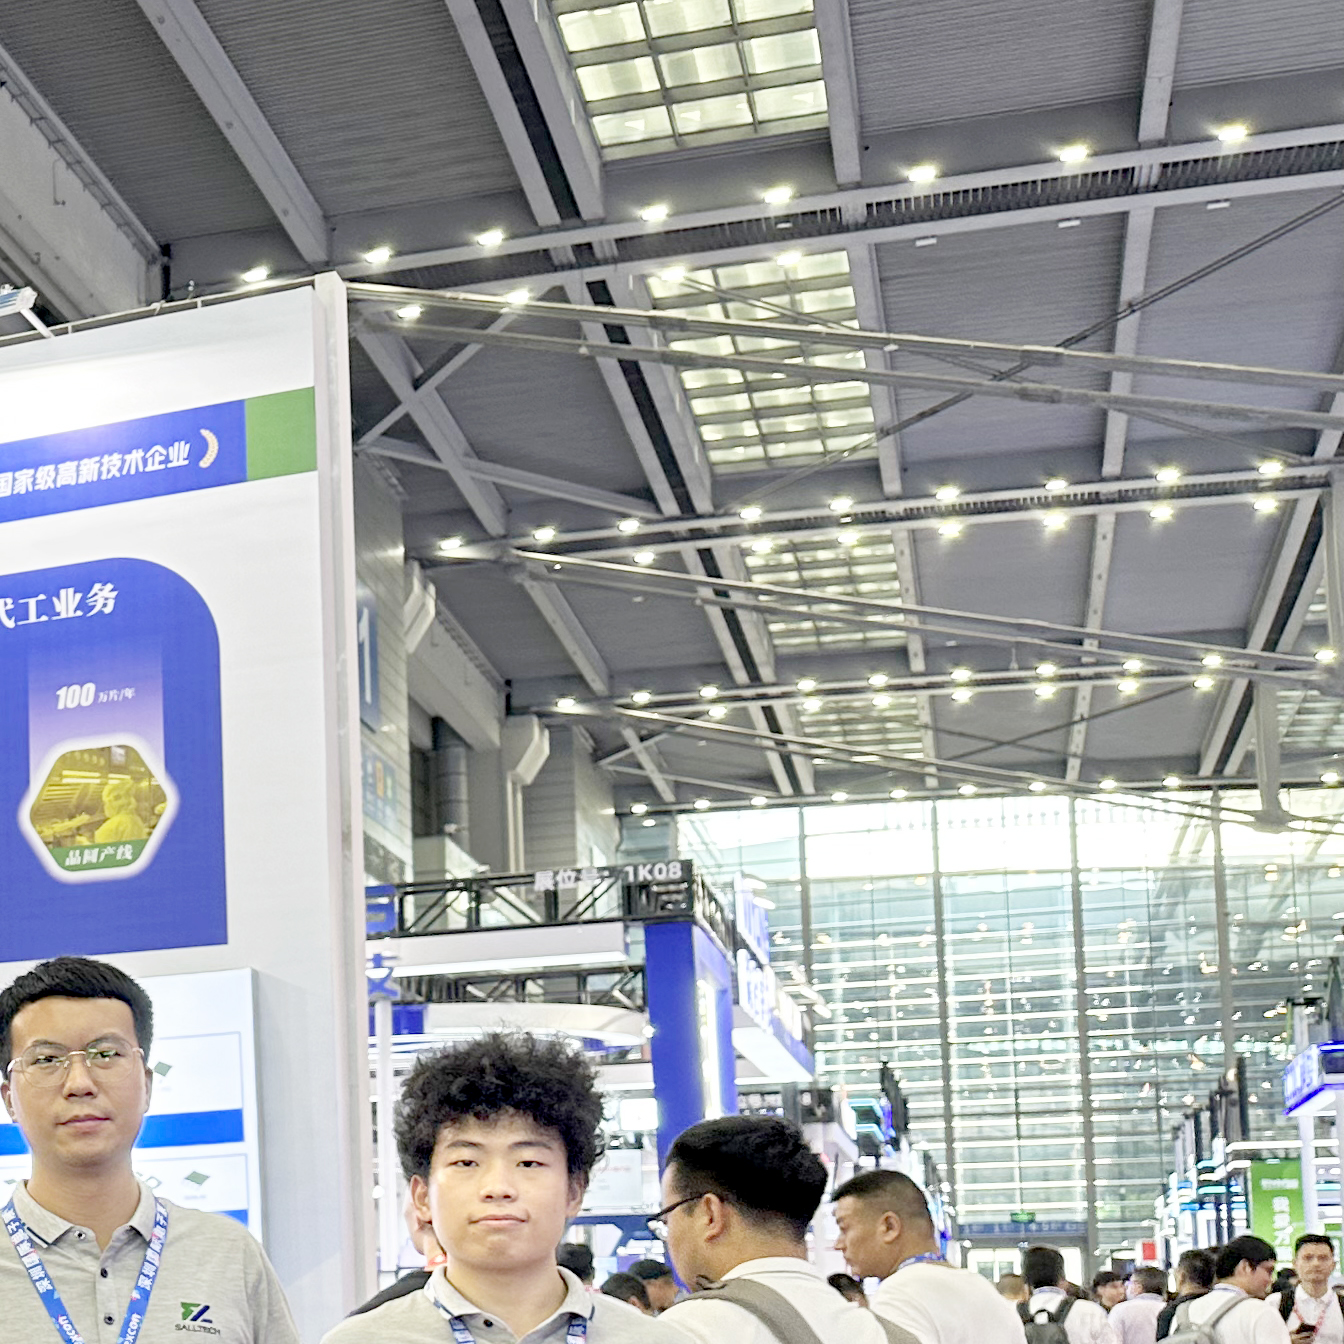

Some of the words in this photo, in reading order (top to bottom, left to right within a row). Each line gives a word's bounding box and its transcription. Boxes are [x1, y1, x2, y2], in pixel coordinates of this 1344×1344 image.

[56, 682, 96, 710] 100
[624, 862, 682, 883] 1K08
[175, 1323, 220, 1336] SALLTECH
